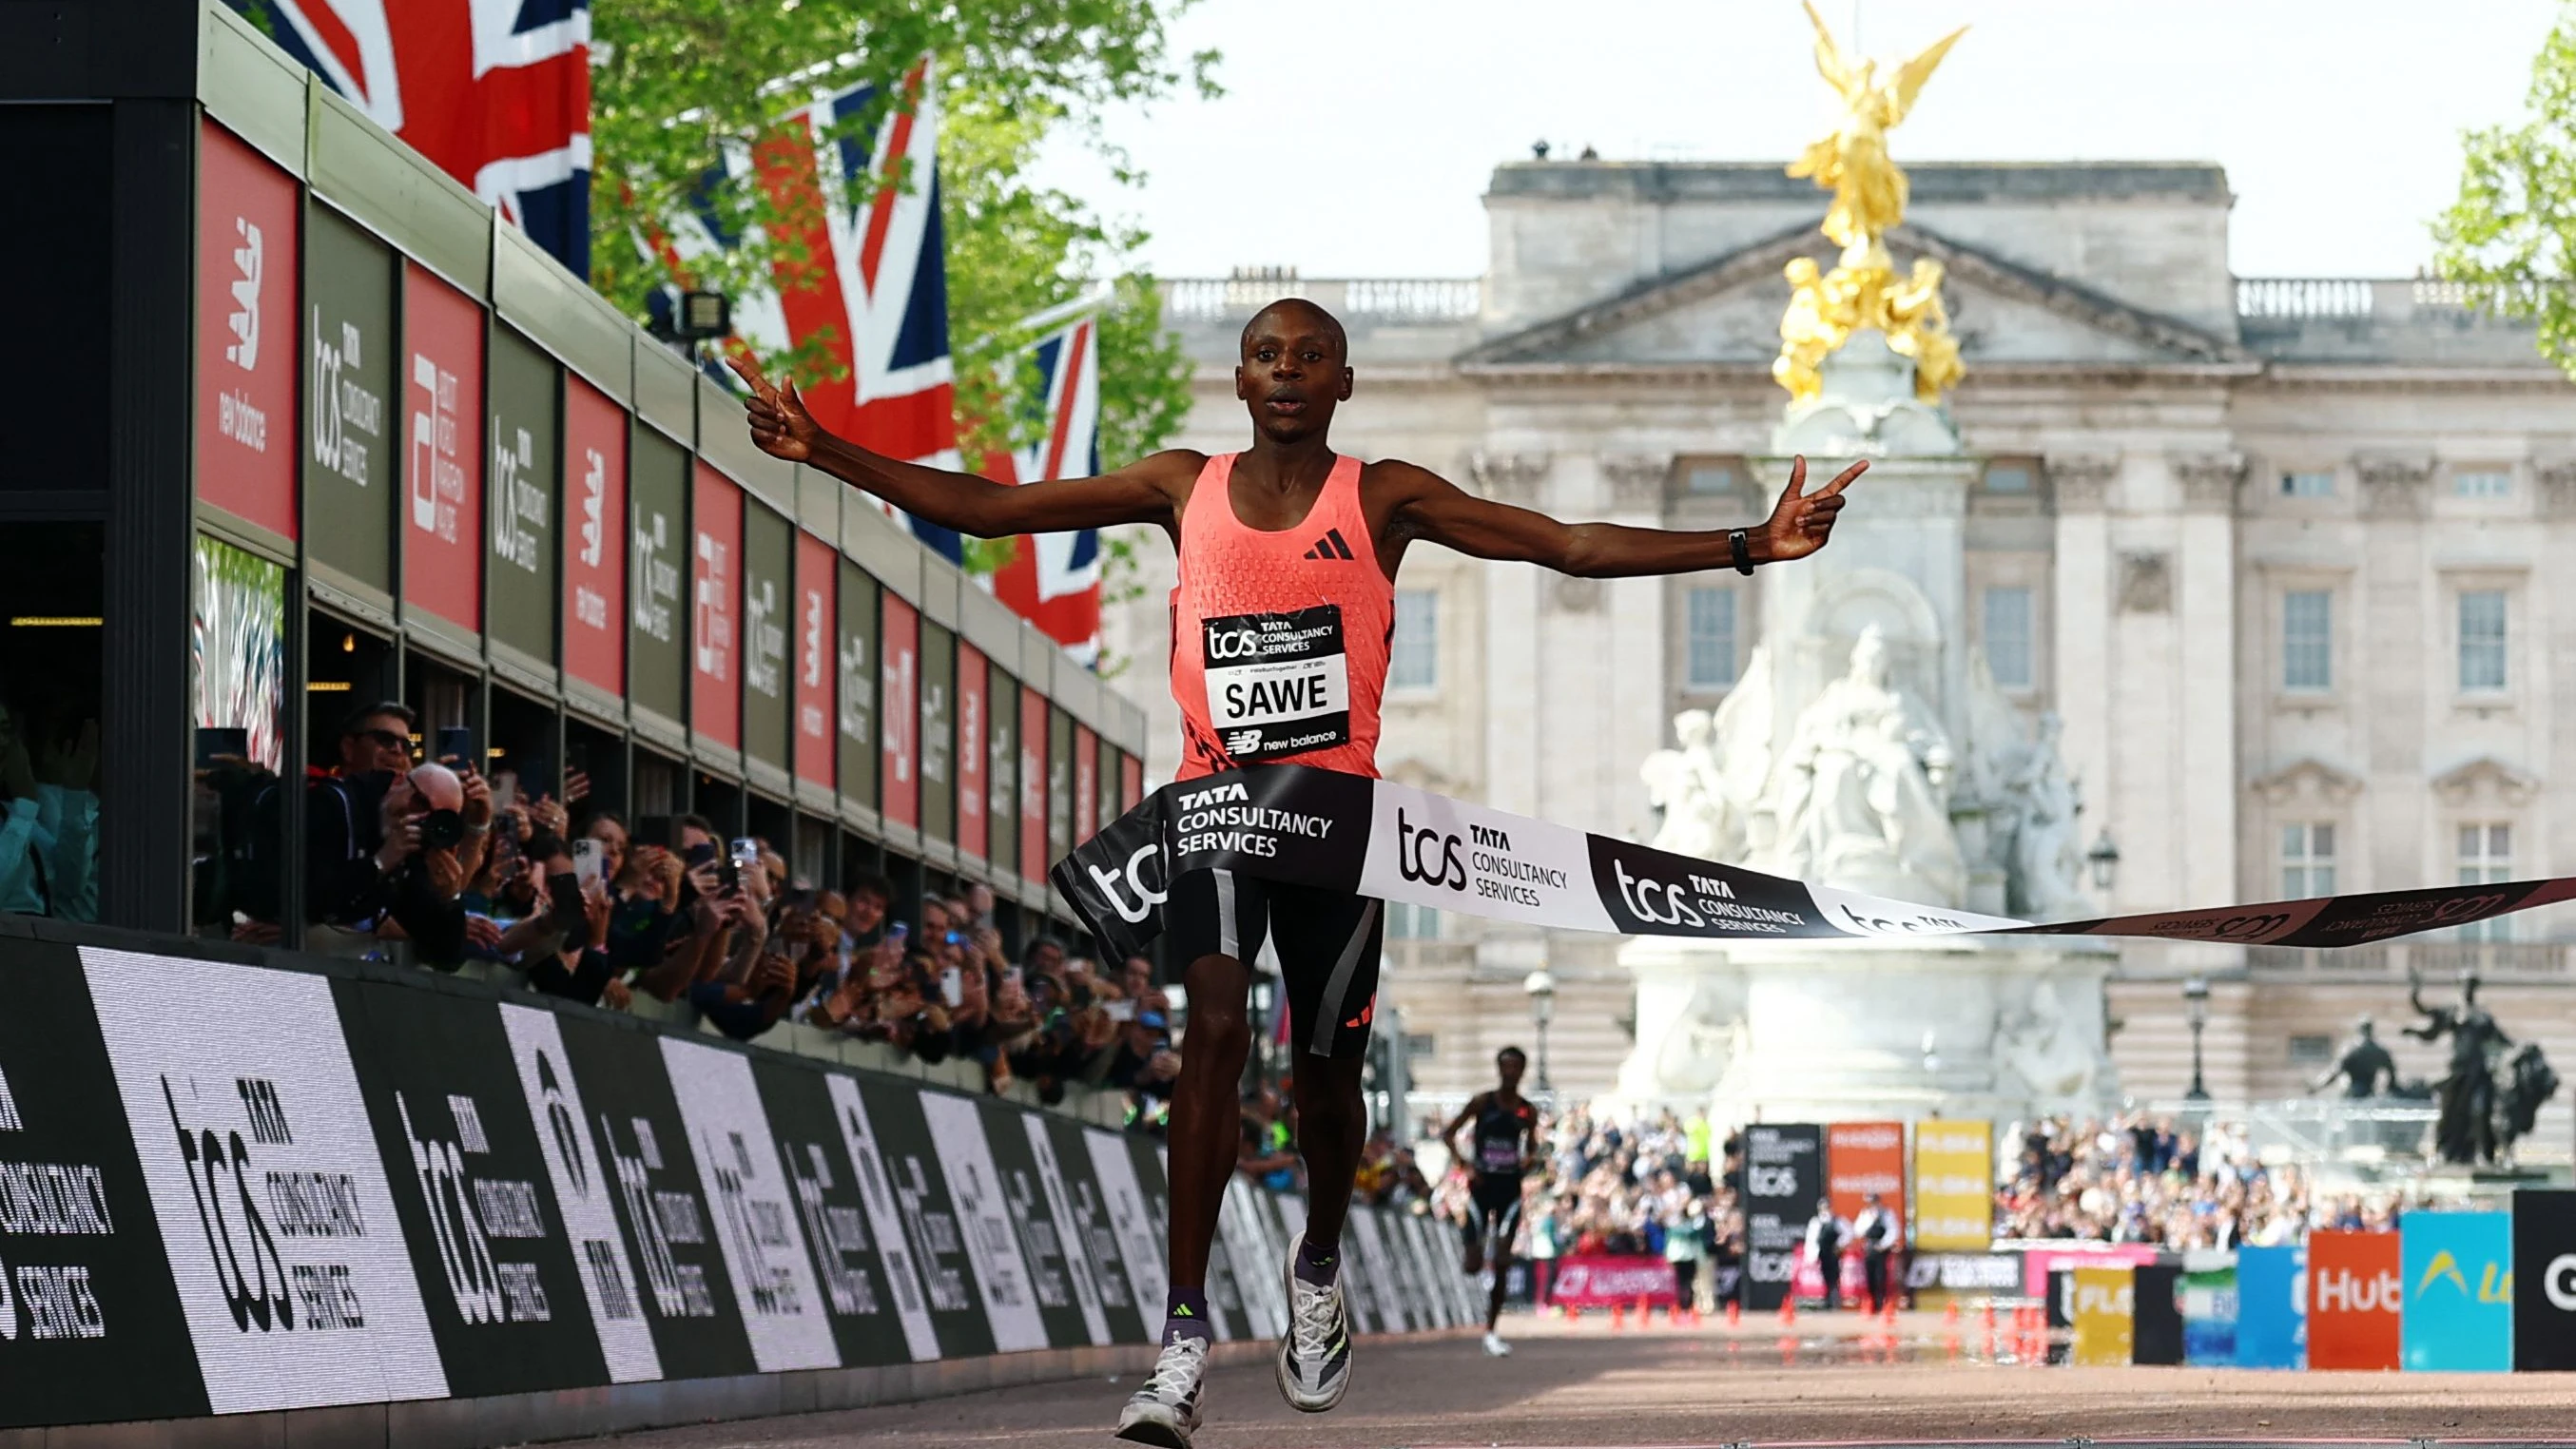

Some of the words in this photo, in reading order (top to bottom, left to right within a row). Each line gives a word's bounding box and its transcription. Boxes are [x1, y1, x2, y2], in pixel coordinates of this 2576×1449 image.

[313, 303, 342, 472] tcs
[494, 415, 517, 561] tcs
[1209, 627, 1256, 660] tcs
[1261, 621, 1292, 632] TATA
[1262, 625, 1333, 645] CONSULTANCY
[1262, 641, 1310, 655] SERVICES
[1226, 674, 1327, 720] SAWE
[1263, 739, 1289, 752] new
[1290, 731, 1337, 748] balance
[1178, 782, 1249, 812] TATA
[1177, 806, 1333, 840] CONSULTANCY
[1470, 823, 1512, 852] TATA
[1177, 831, 1278, 858] SERVICES
[1398, 806, 1467, 892] tcs
[1472, 851, 1568, 890] CONSULTANCY
[1688, 874, 1736, 899] TATA
[1476, 878, 1541, 907] SERVICES
[1614, 859, 1706, 928] tcs
[1697, 898, 1806, 926] CONSULTANCY
[1711, 918, 1787, 934] SERVICES
[236, 1076, 293, 1145] TATA
[447, 1094, 491, 1154] TATA
[1748, 1165, 1799, 1197] tcs
[159, 1073, 295, 1333] tcs
[265, 1170, 367, 1238] CONSULTANCY
[395, 1091, 505, 1325] tcs
[474, 1179, 547, 1238] CONSULTANCY
[16, 1265, 106, 1340] SERVICES
[292, 1265, 364, 1330] SERVICES
[497, 1263, 552, 1323] SERVICES
